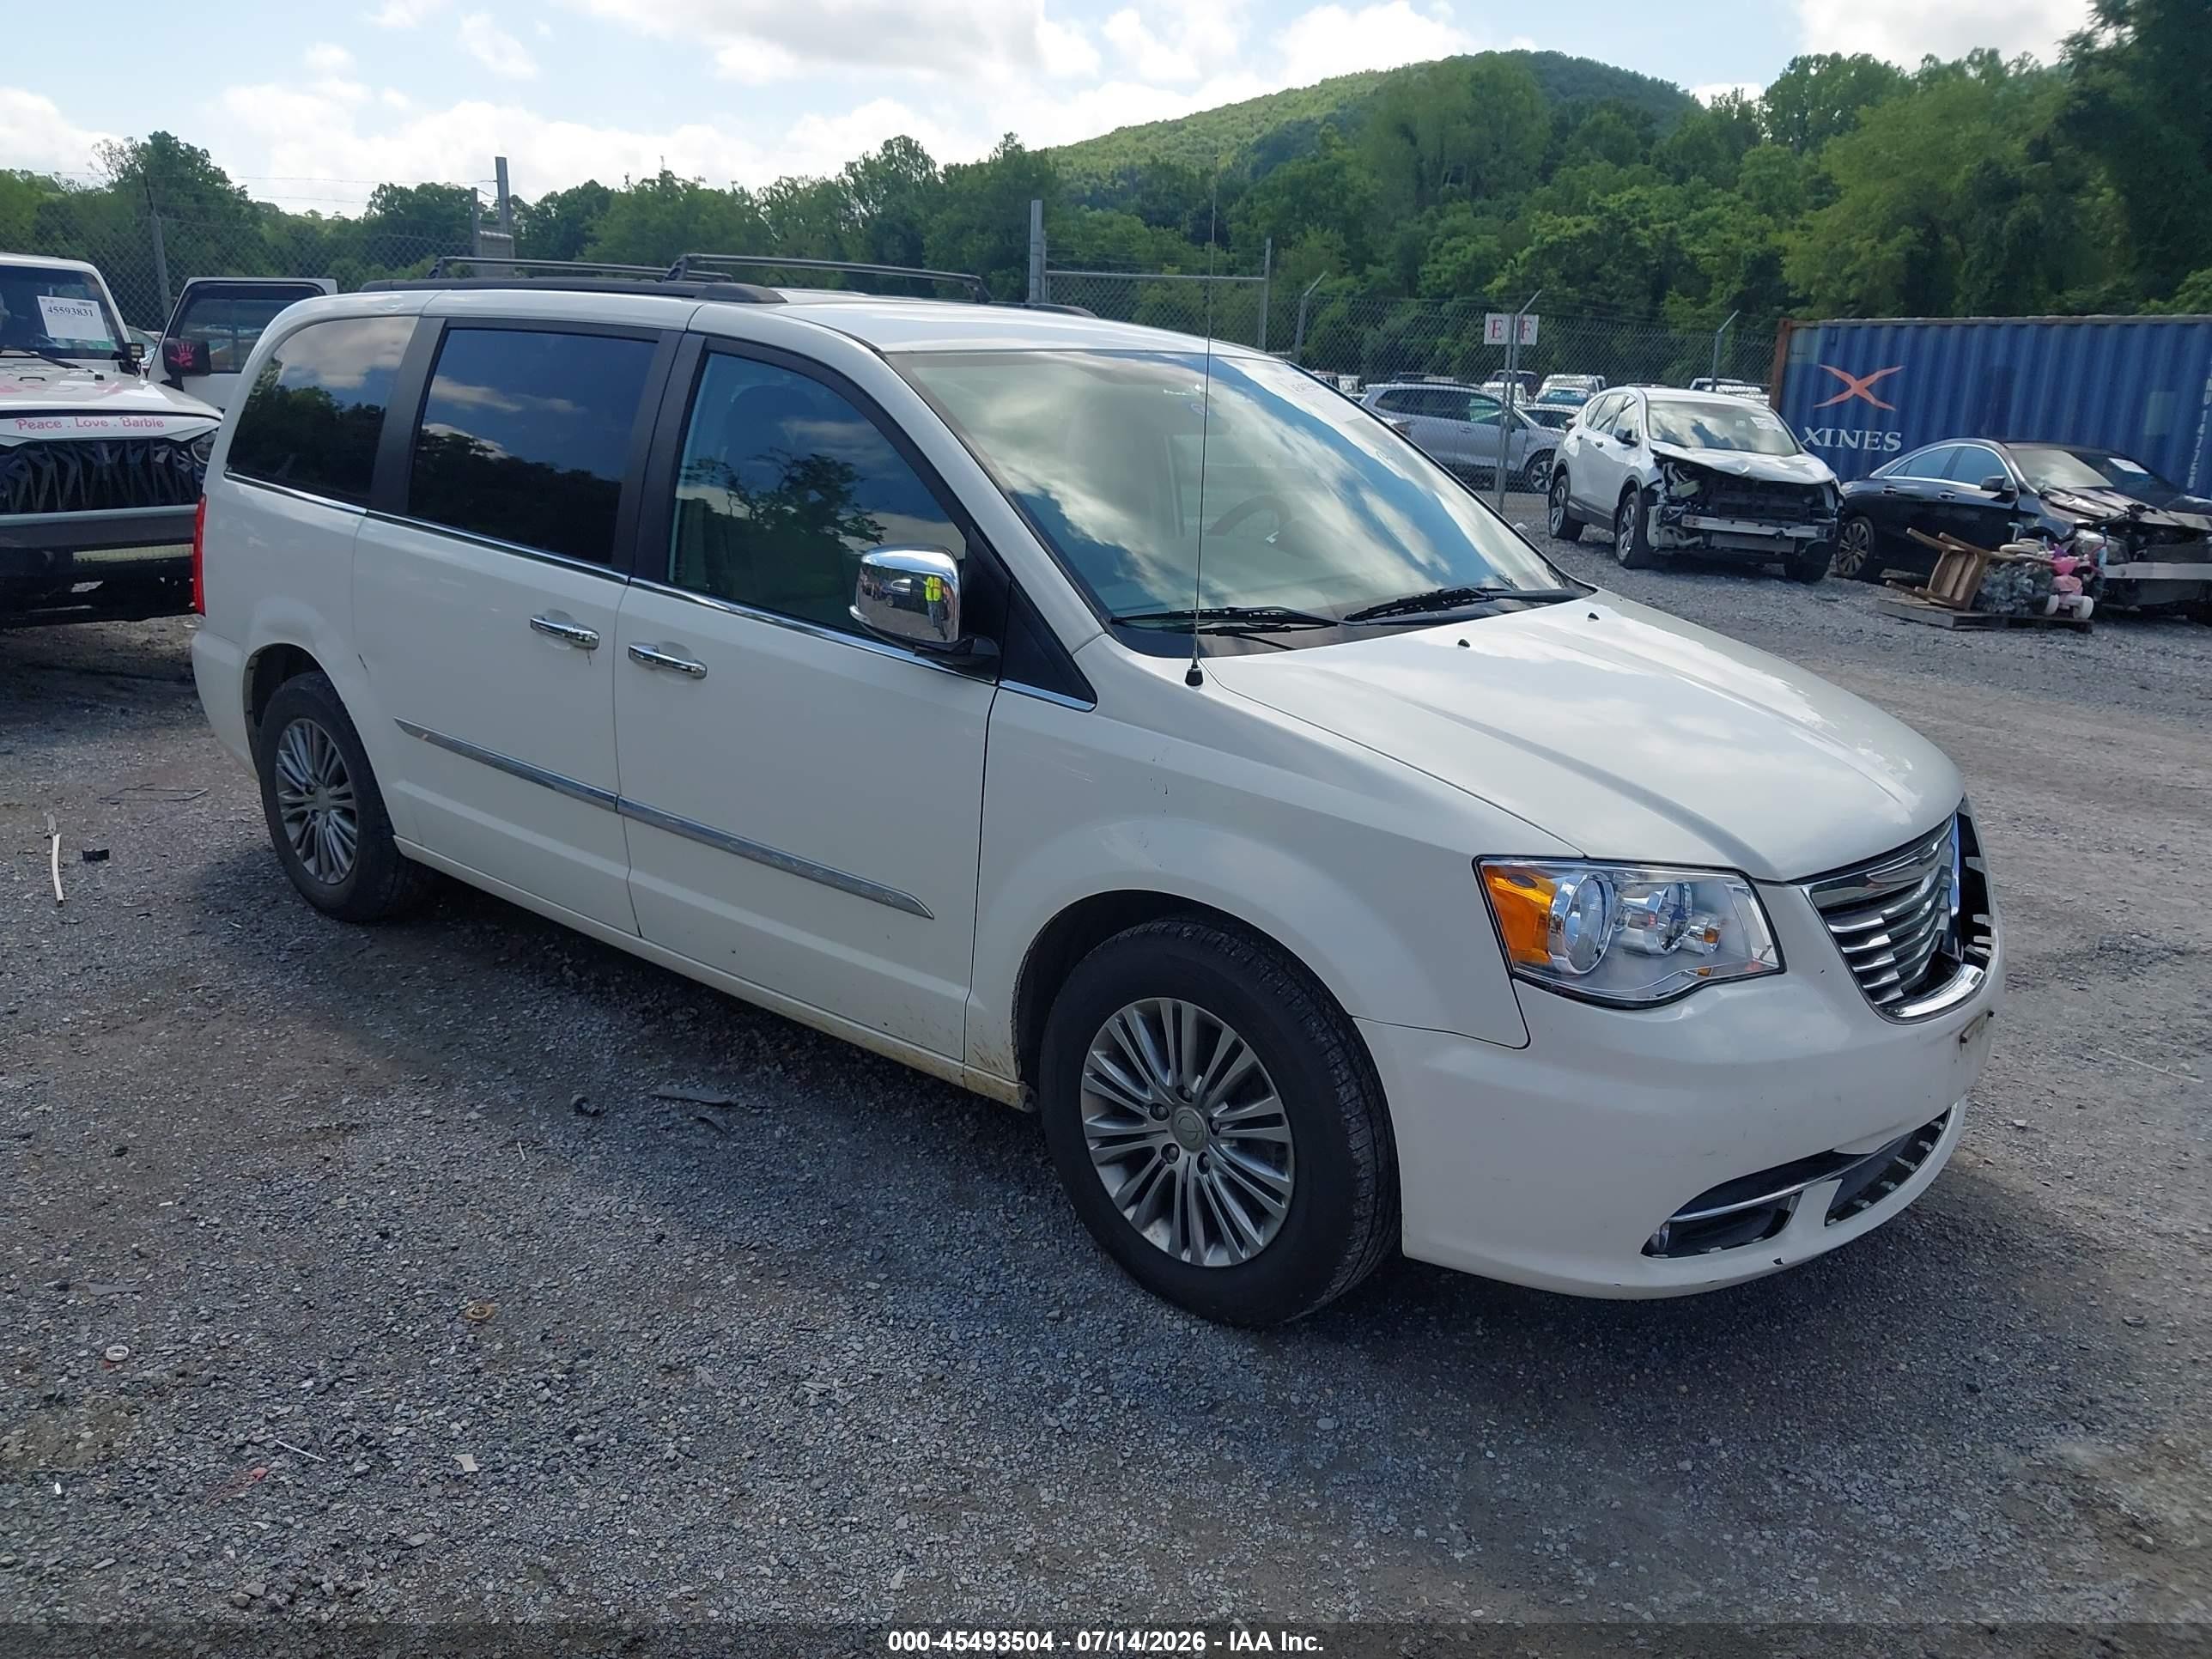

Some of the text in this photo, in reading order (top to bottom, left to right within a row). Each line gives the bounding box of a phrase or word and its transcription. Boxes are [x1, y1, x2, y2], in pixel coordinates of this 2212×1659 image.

[47, 306, 94, 317] 45593831
[1491, 319, 1533, 339] E F
[15, 418, 63, 430] Peace
[75, 417, 109, 428] Love
[119, 416, 165, 428] Barbie
[1800, 426, 1902, 453] XINES
